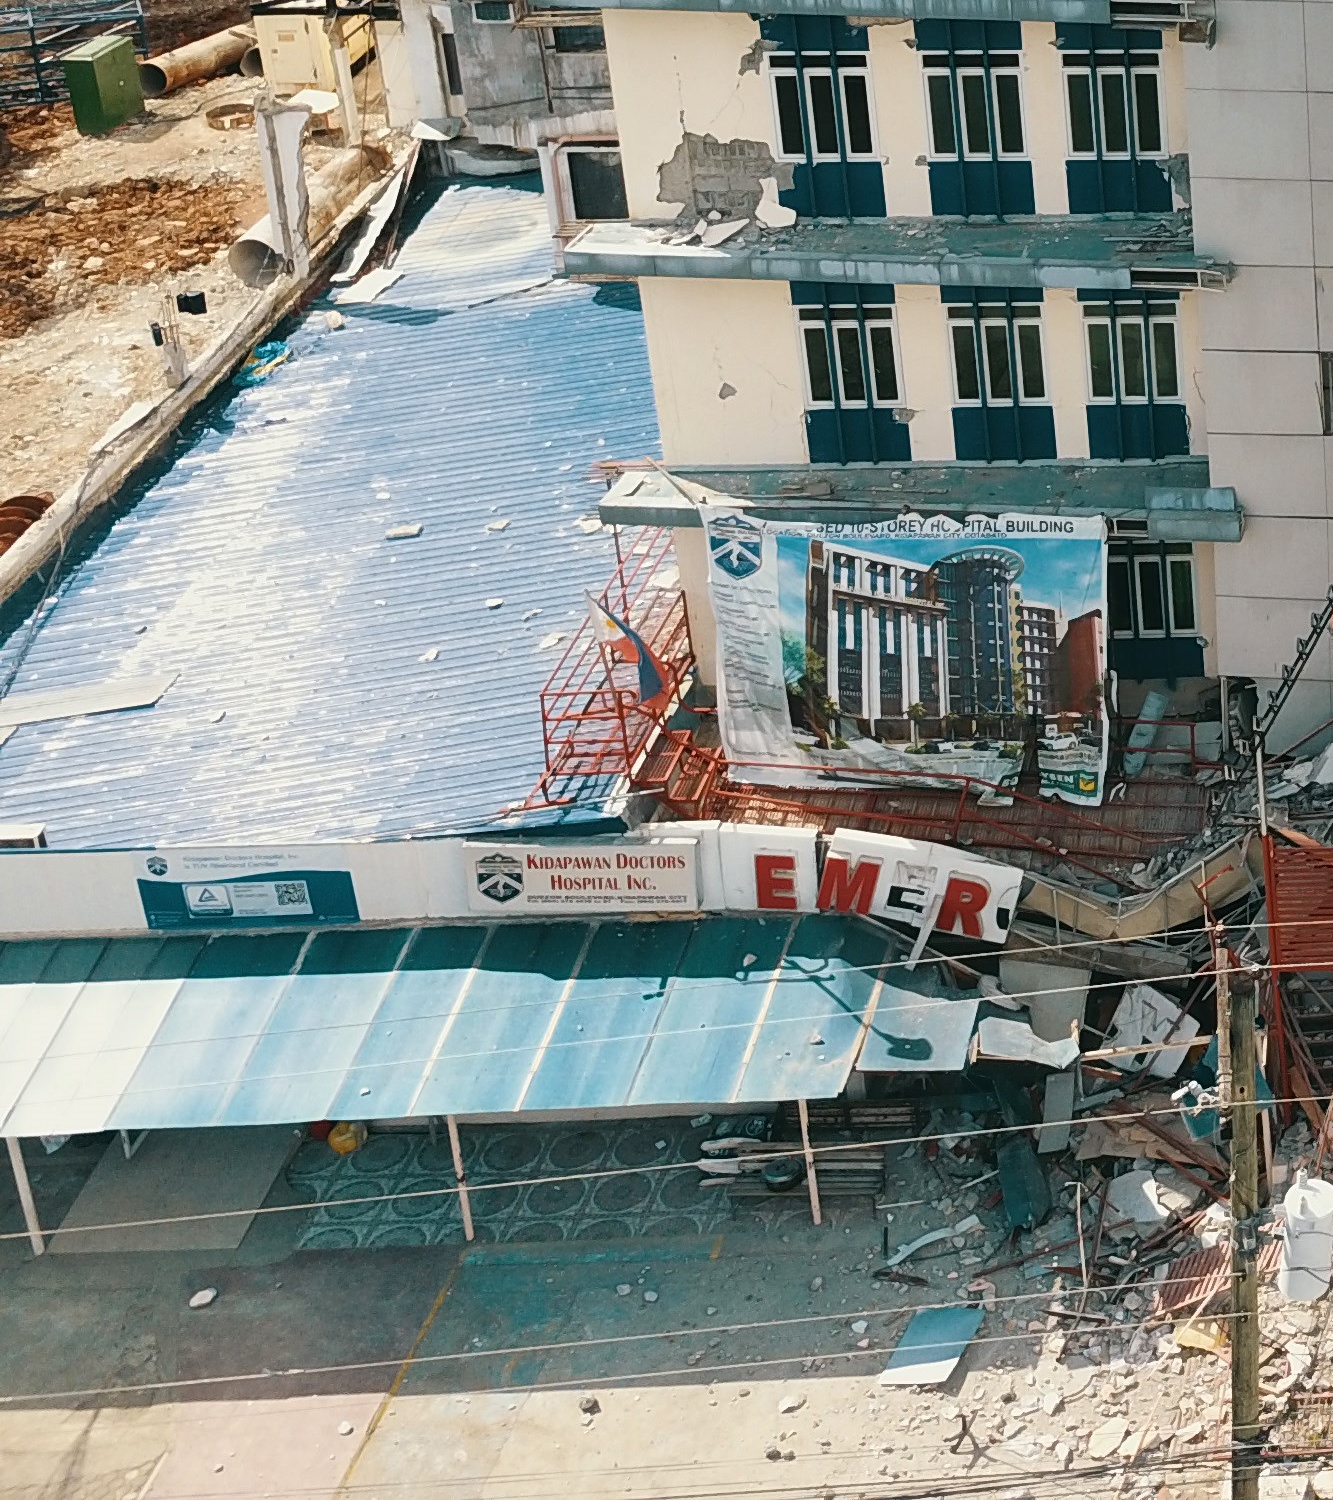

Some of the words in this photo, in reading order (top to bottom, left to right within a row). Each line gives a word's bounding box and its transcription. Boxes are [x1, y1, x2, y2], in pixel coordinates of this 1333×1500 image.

[930, 520, 1001, 533] HOPITAL
[1006, 520, 1074, 533] BUILDING
[526, 853, 611, 870] KIDAPAWAN
[616, 853, 686, 870] DOCTORS
[550, 874, 622, 891] HOSPITAL
[626, 874, 657, 891] INC.
